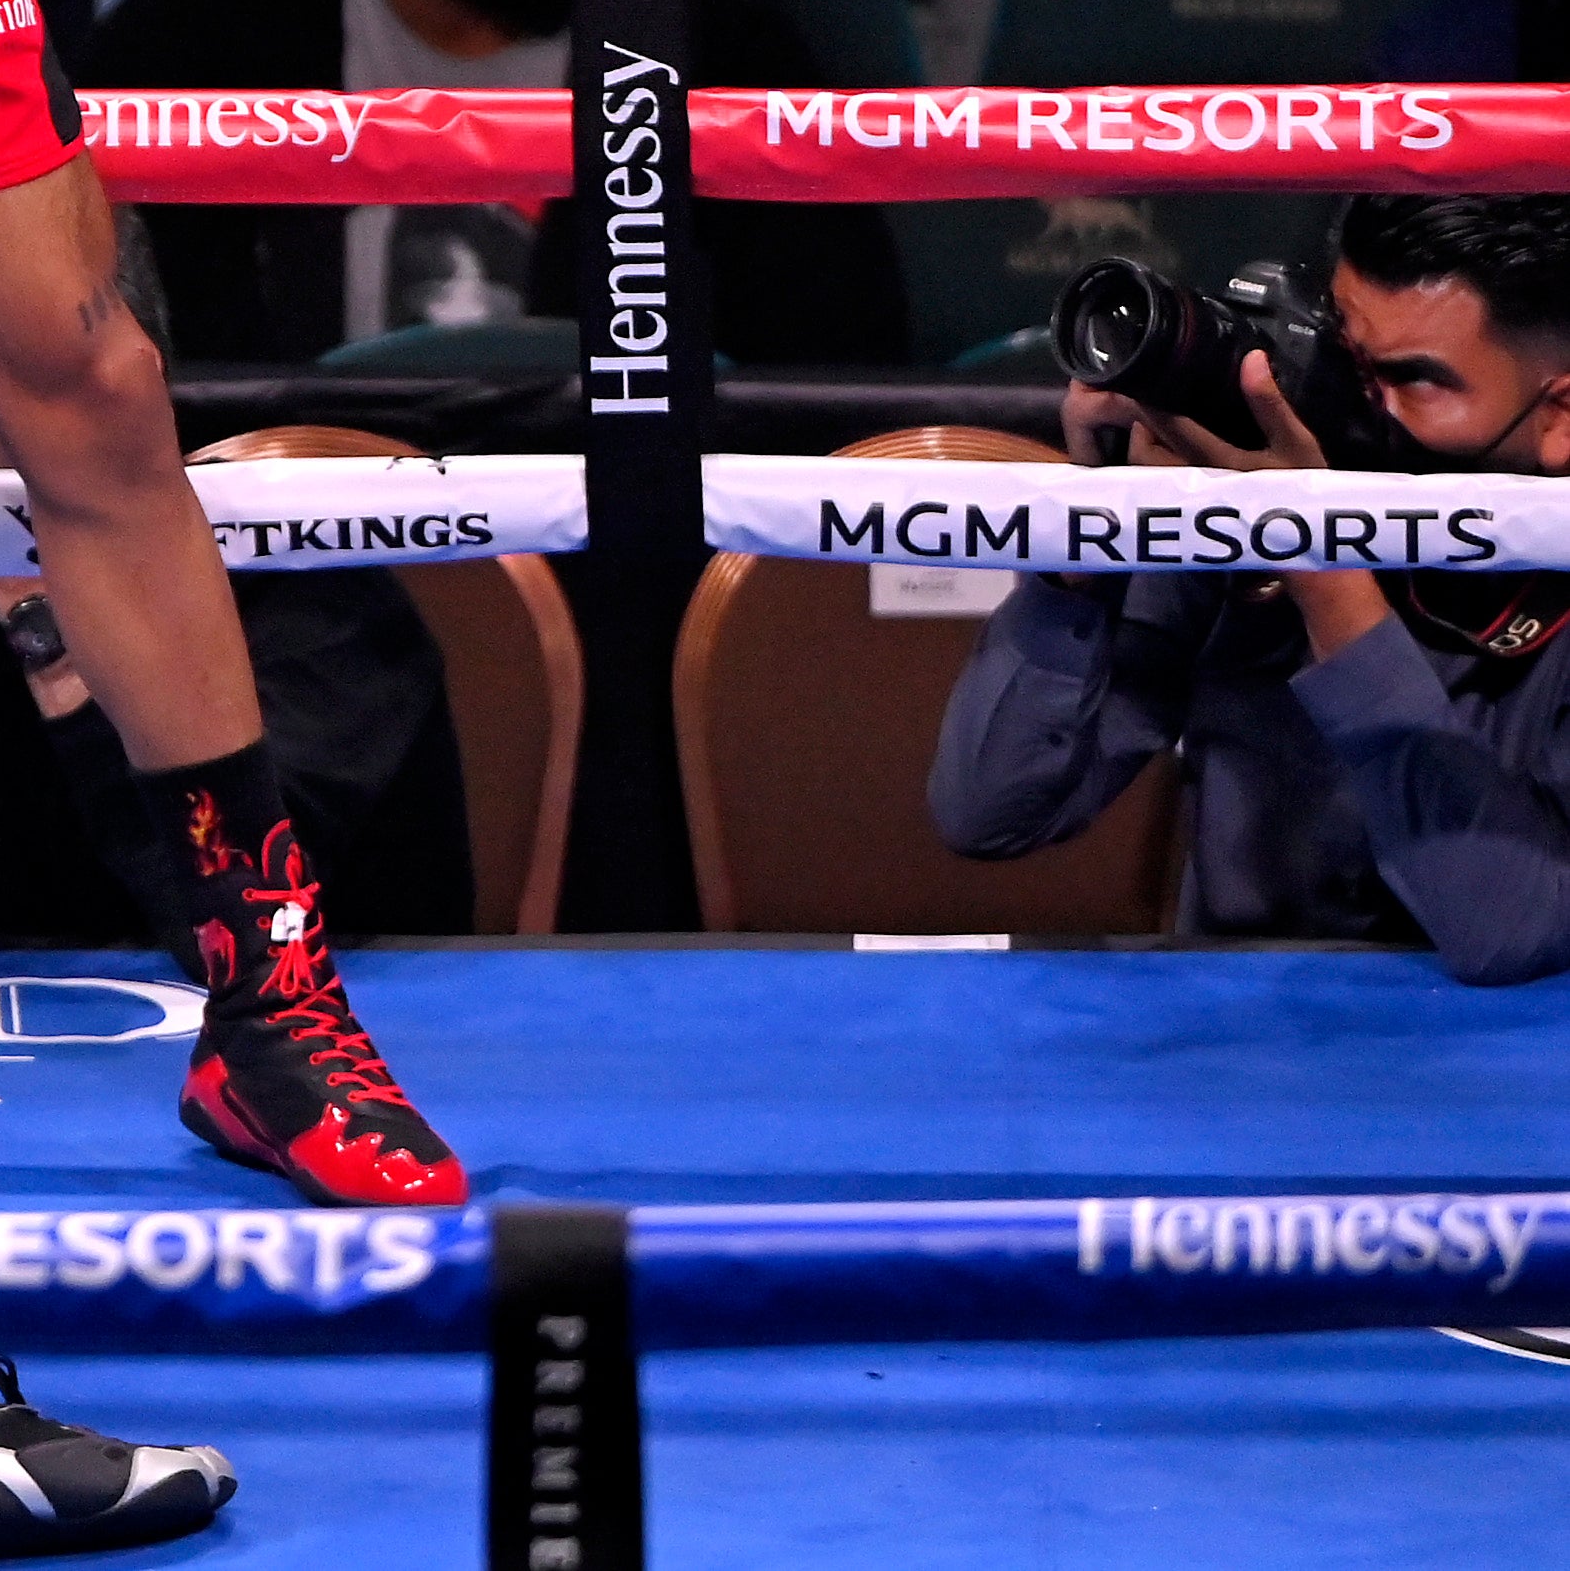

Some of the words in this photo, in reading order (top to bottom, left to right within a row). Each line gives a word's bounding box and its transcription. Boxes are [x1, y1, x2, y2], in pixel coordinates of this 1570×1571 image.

[79, 96, 373, 163] ennessy
[765, 90, 981, 149] MGM
[1017, 89, 1454, 152] RESORTS
[589, 41, 679, 415] Hennessy
[819, 498, 1029, 560] MGM
[1067, 504, 1497, 565] RESORTS
[1074, 1198, 1540, 1294] Hennessy
